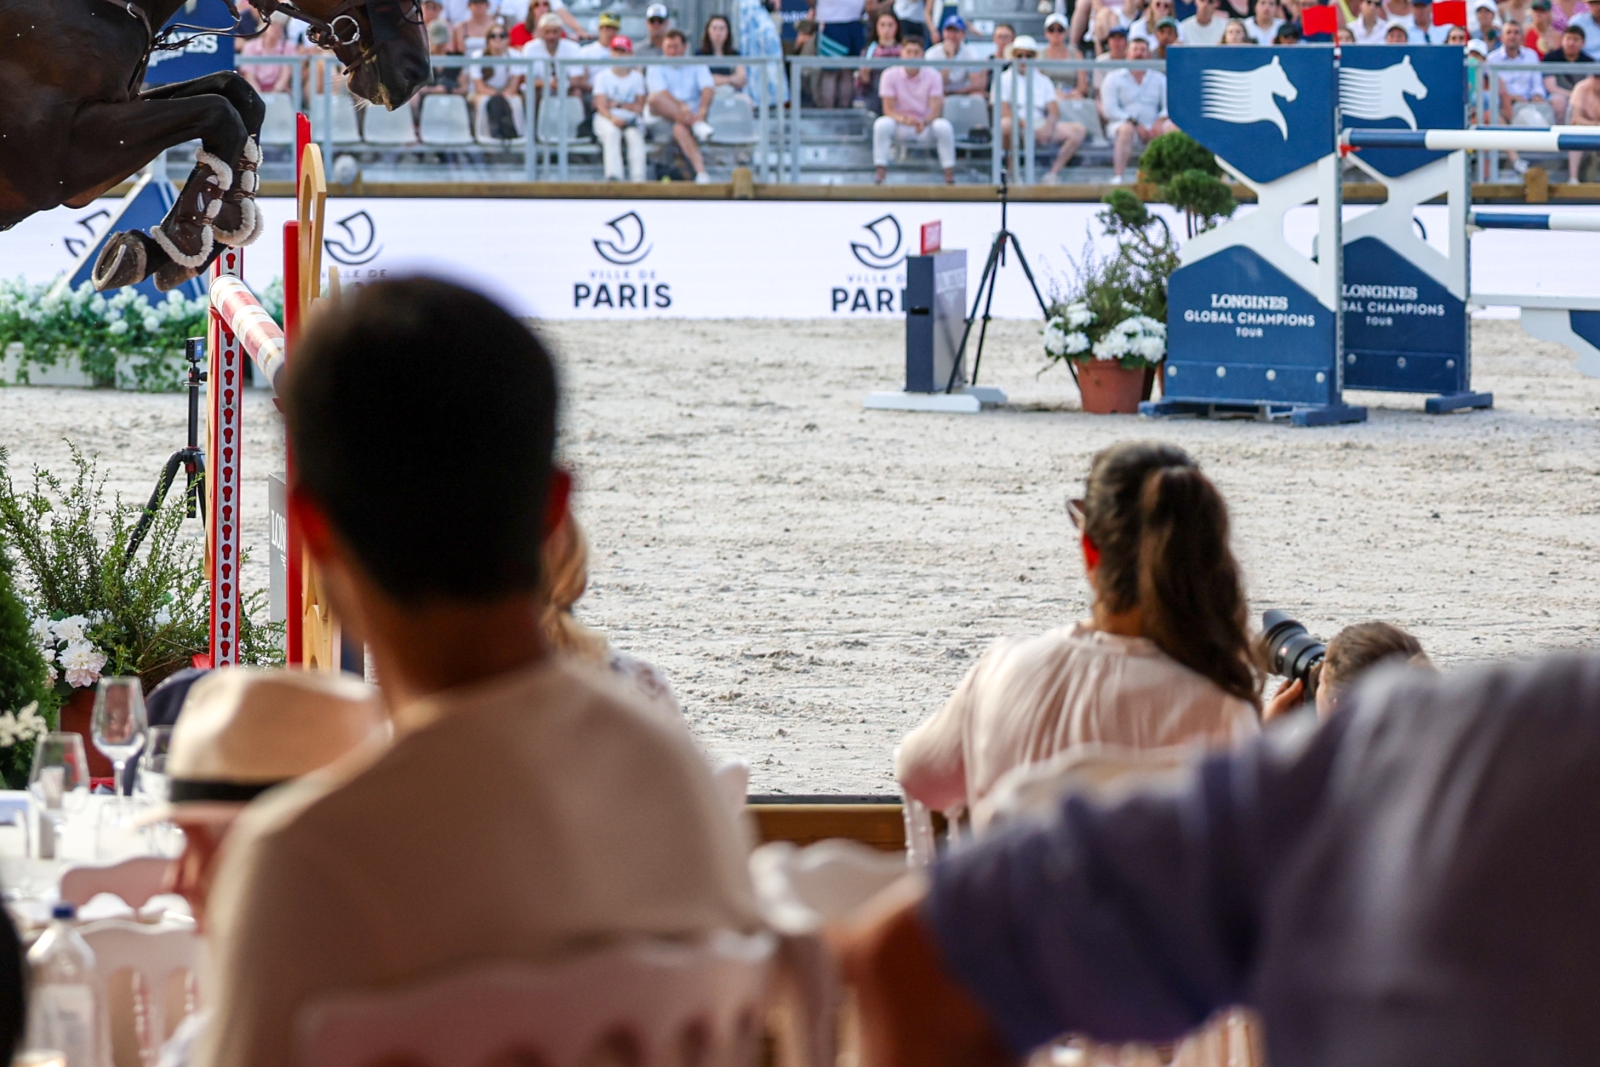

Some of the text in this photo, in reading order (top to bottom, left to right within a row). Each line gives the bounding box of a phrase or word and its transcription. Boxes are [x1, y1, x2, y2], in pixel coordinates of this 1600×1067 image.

[574, 283, 672, 308] PARIS
[832, 288, 906, 313] PARI
[1211, 294, 1288, 311] LONGINES
[1367, 301, 1445, 317] CHAMPIONS
[1184, 309, 1316, 327] GLOBAL CHAMPIONS
[1366, 315, 1393, 327] TOUR
[1235, 326, 1264, 338] TOUR
